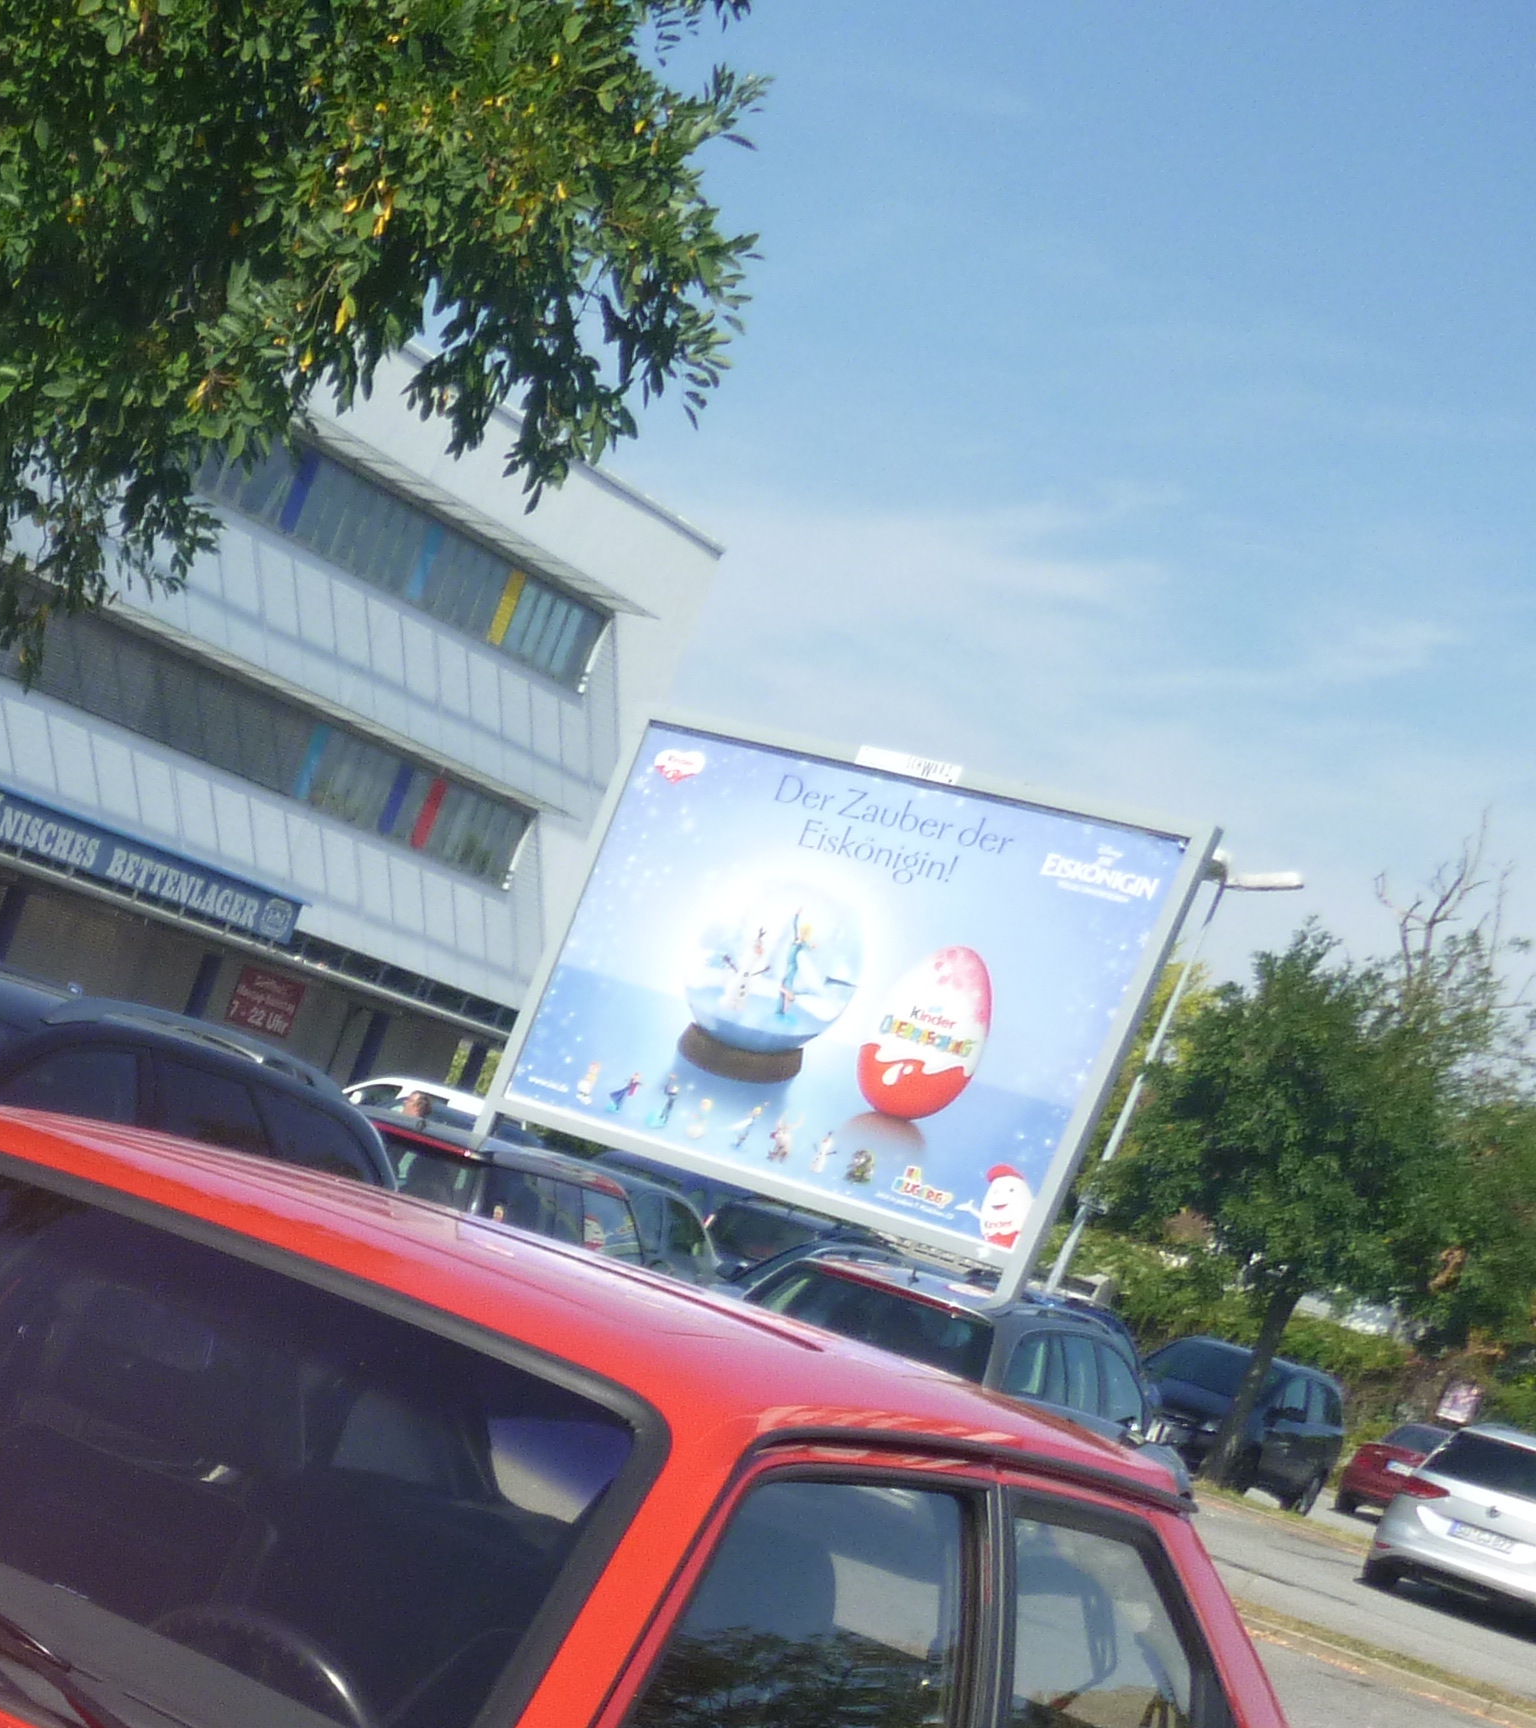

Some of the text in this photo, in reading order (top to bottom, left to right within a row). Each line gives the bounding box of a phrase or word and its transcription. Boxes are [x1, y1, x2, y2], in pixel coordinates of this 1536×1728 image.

[774, 773, 1017, 857] Der Zauber der
[797, 817, 960, 886] Eiskönigin!
[106, 848, 260, 929] BETTENLAGER
[265, 1012, 289, 1034] Uhr
